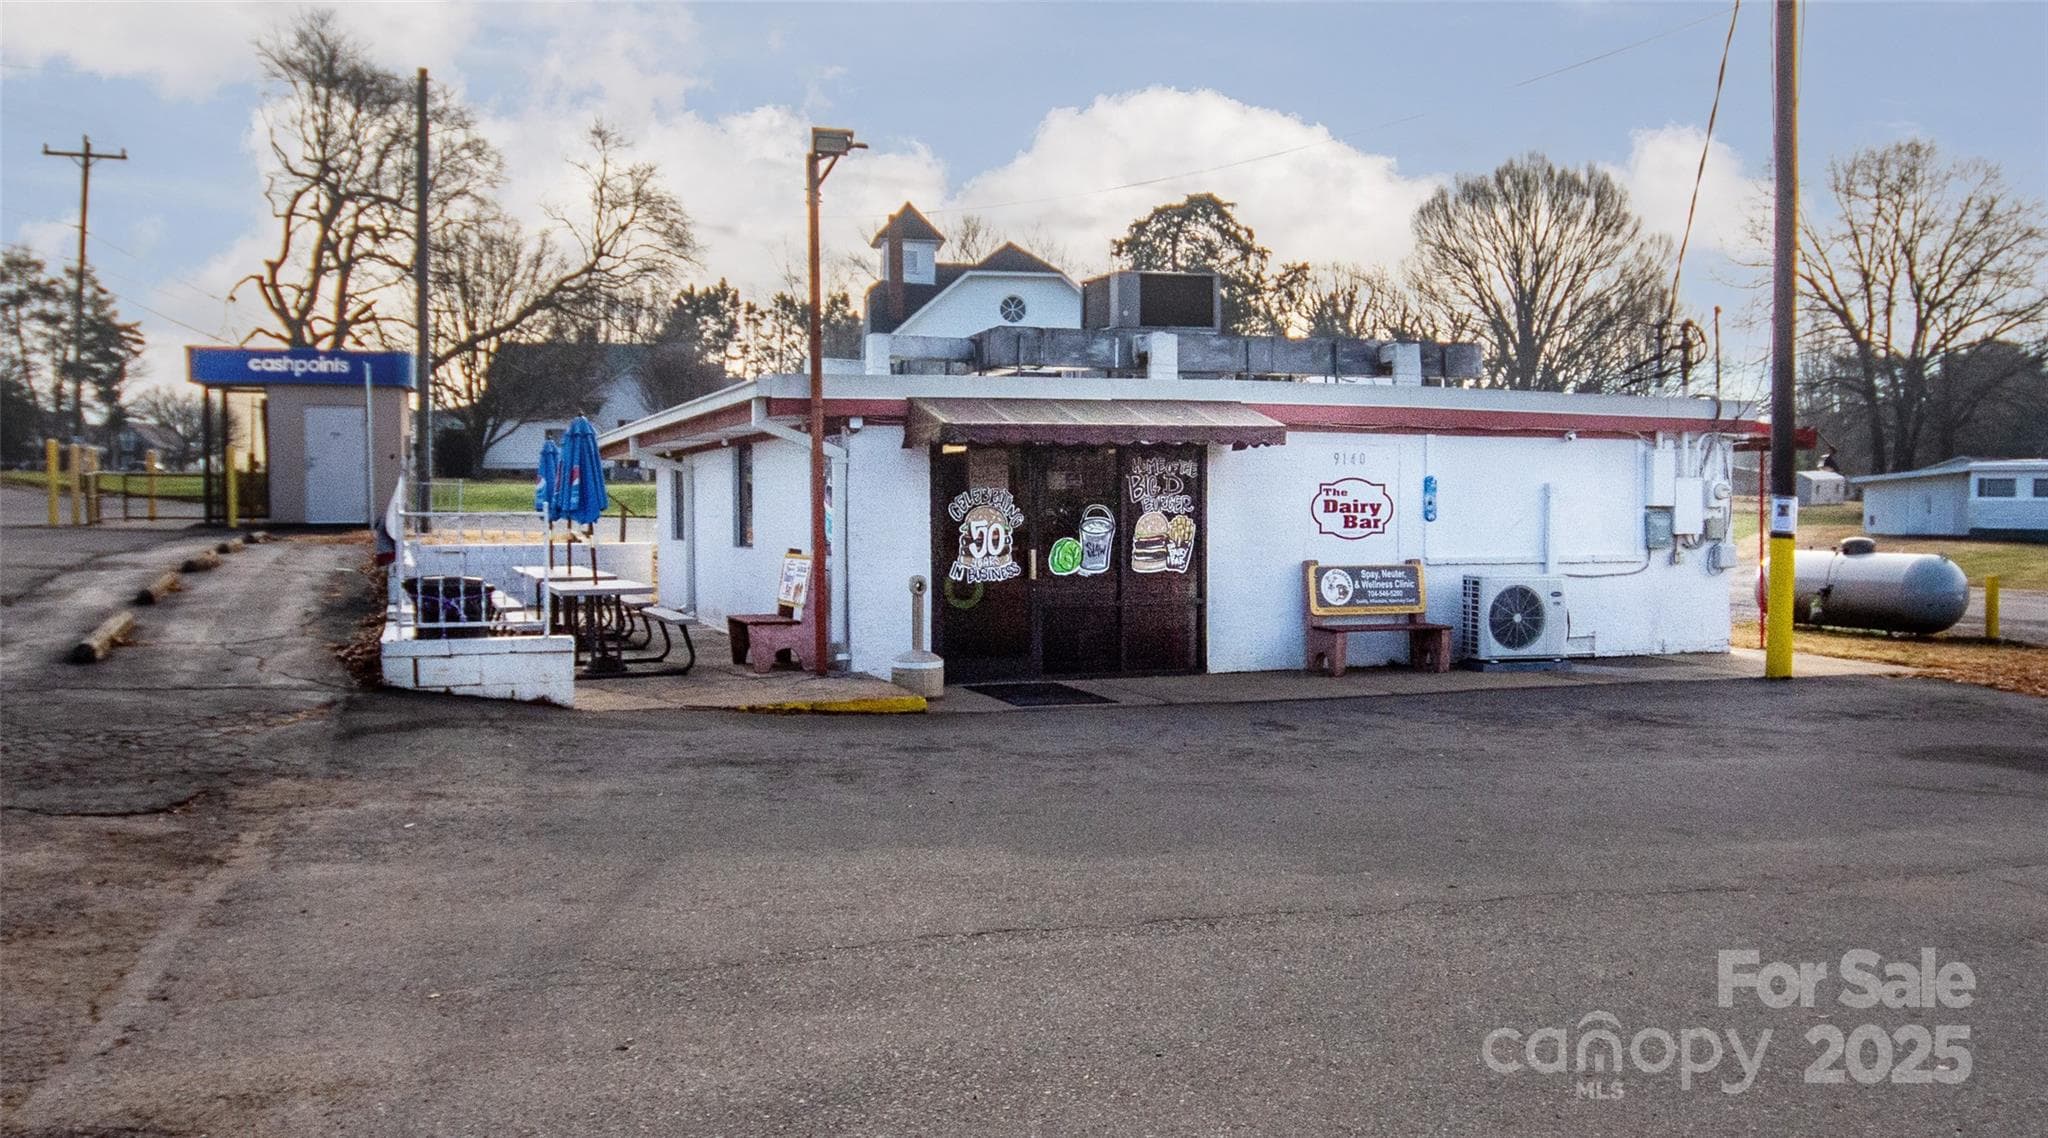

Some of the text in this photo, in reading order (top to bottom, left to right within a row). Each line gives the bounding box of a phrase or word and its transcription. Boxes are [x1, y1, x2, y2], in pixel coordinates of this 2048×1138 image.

[247, 355, 350, 377] cashpoints
[1131, 456, 1166, 475] HOME
[1126, 474, 1184, 503] BIG D
[1323, 488, 1348, 496] The
[948, 487, 1024, 528] CELEBRATING
[1141, 495, 1195, 514] BURGER
[1323, 499, 1382, 517] Dairy
[1343, 515, 1382, 529] Bar
[969, 520, 1006, 559] 50
[949, 561, 1021, 584] IN BUSINESS
[1382, 570, 1407, 579] Neuter,
[1354, 579, 1415, 589] & Wellness Clinic
